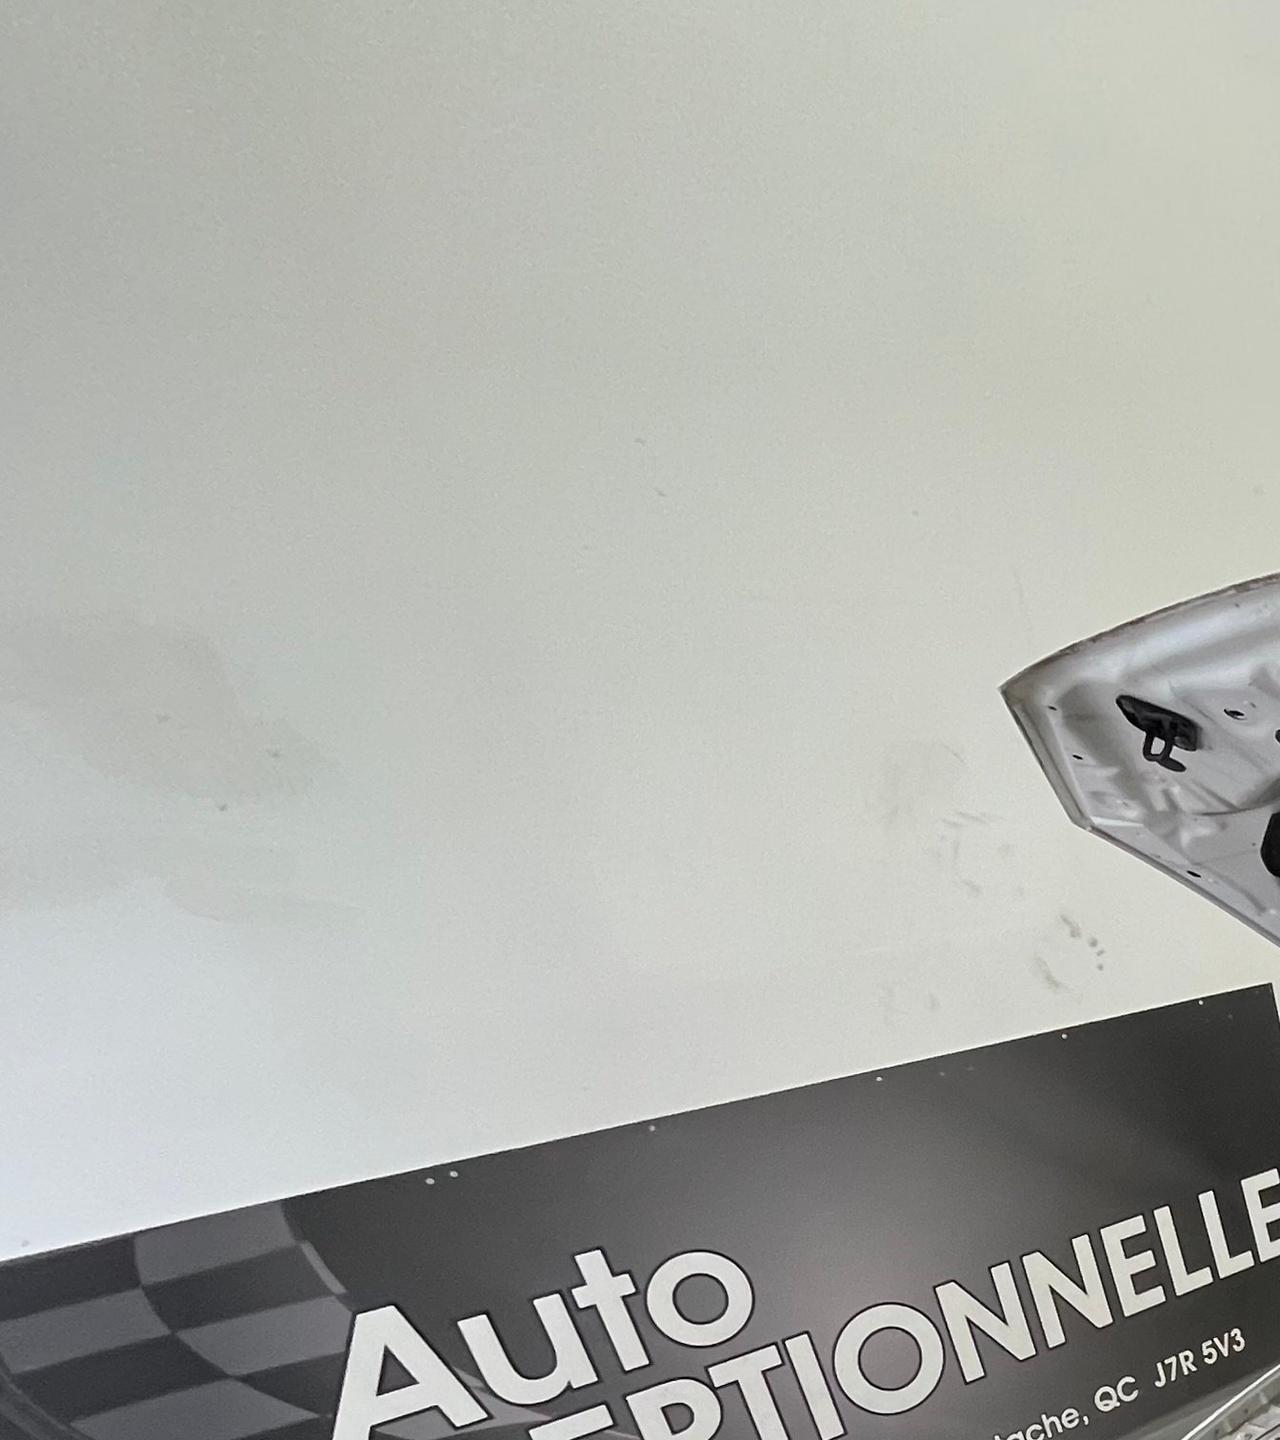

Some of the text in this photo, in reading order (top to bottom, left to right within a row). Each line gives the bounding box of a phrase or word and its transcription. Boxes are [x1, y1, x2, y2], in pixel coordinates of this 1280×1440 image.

[1094, 1376, 1140, 1413] QC
[1154, 1349, 1198, 1388] J7R
[1202, 1327, 1246, 1365] 5V3
